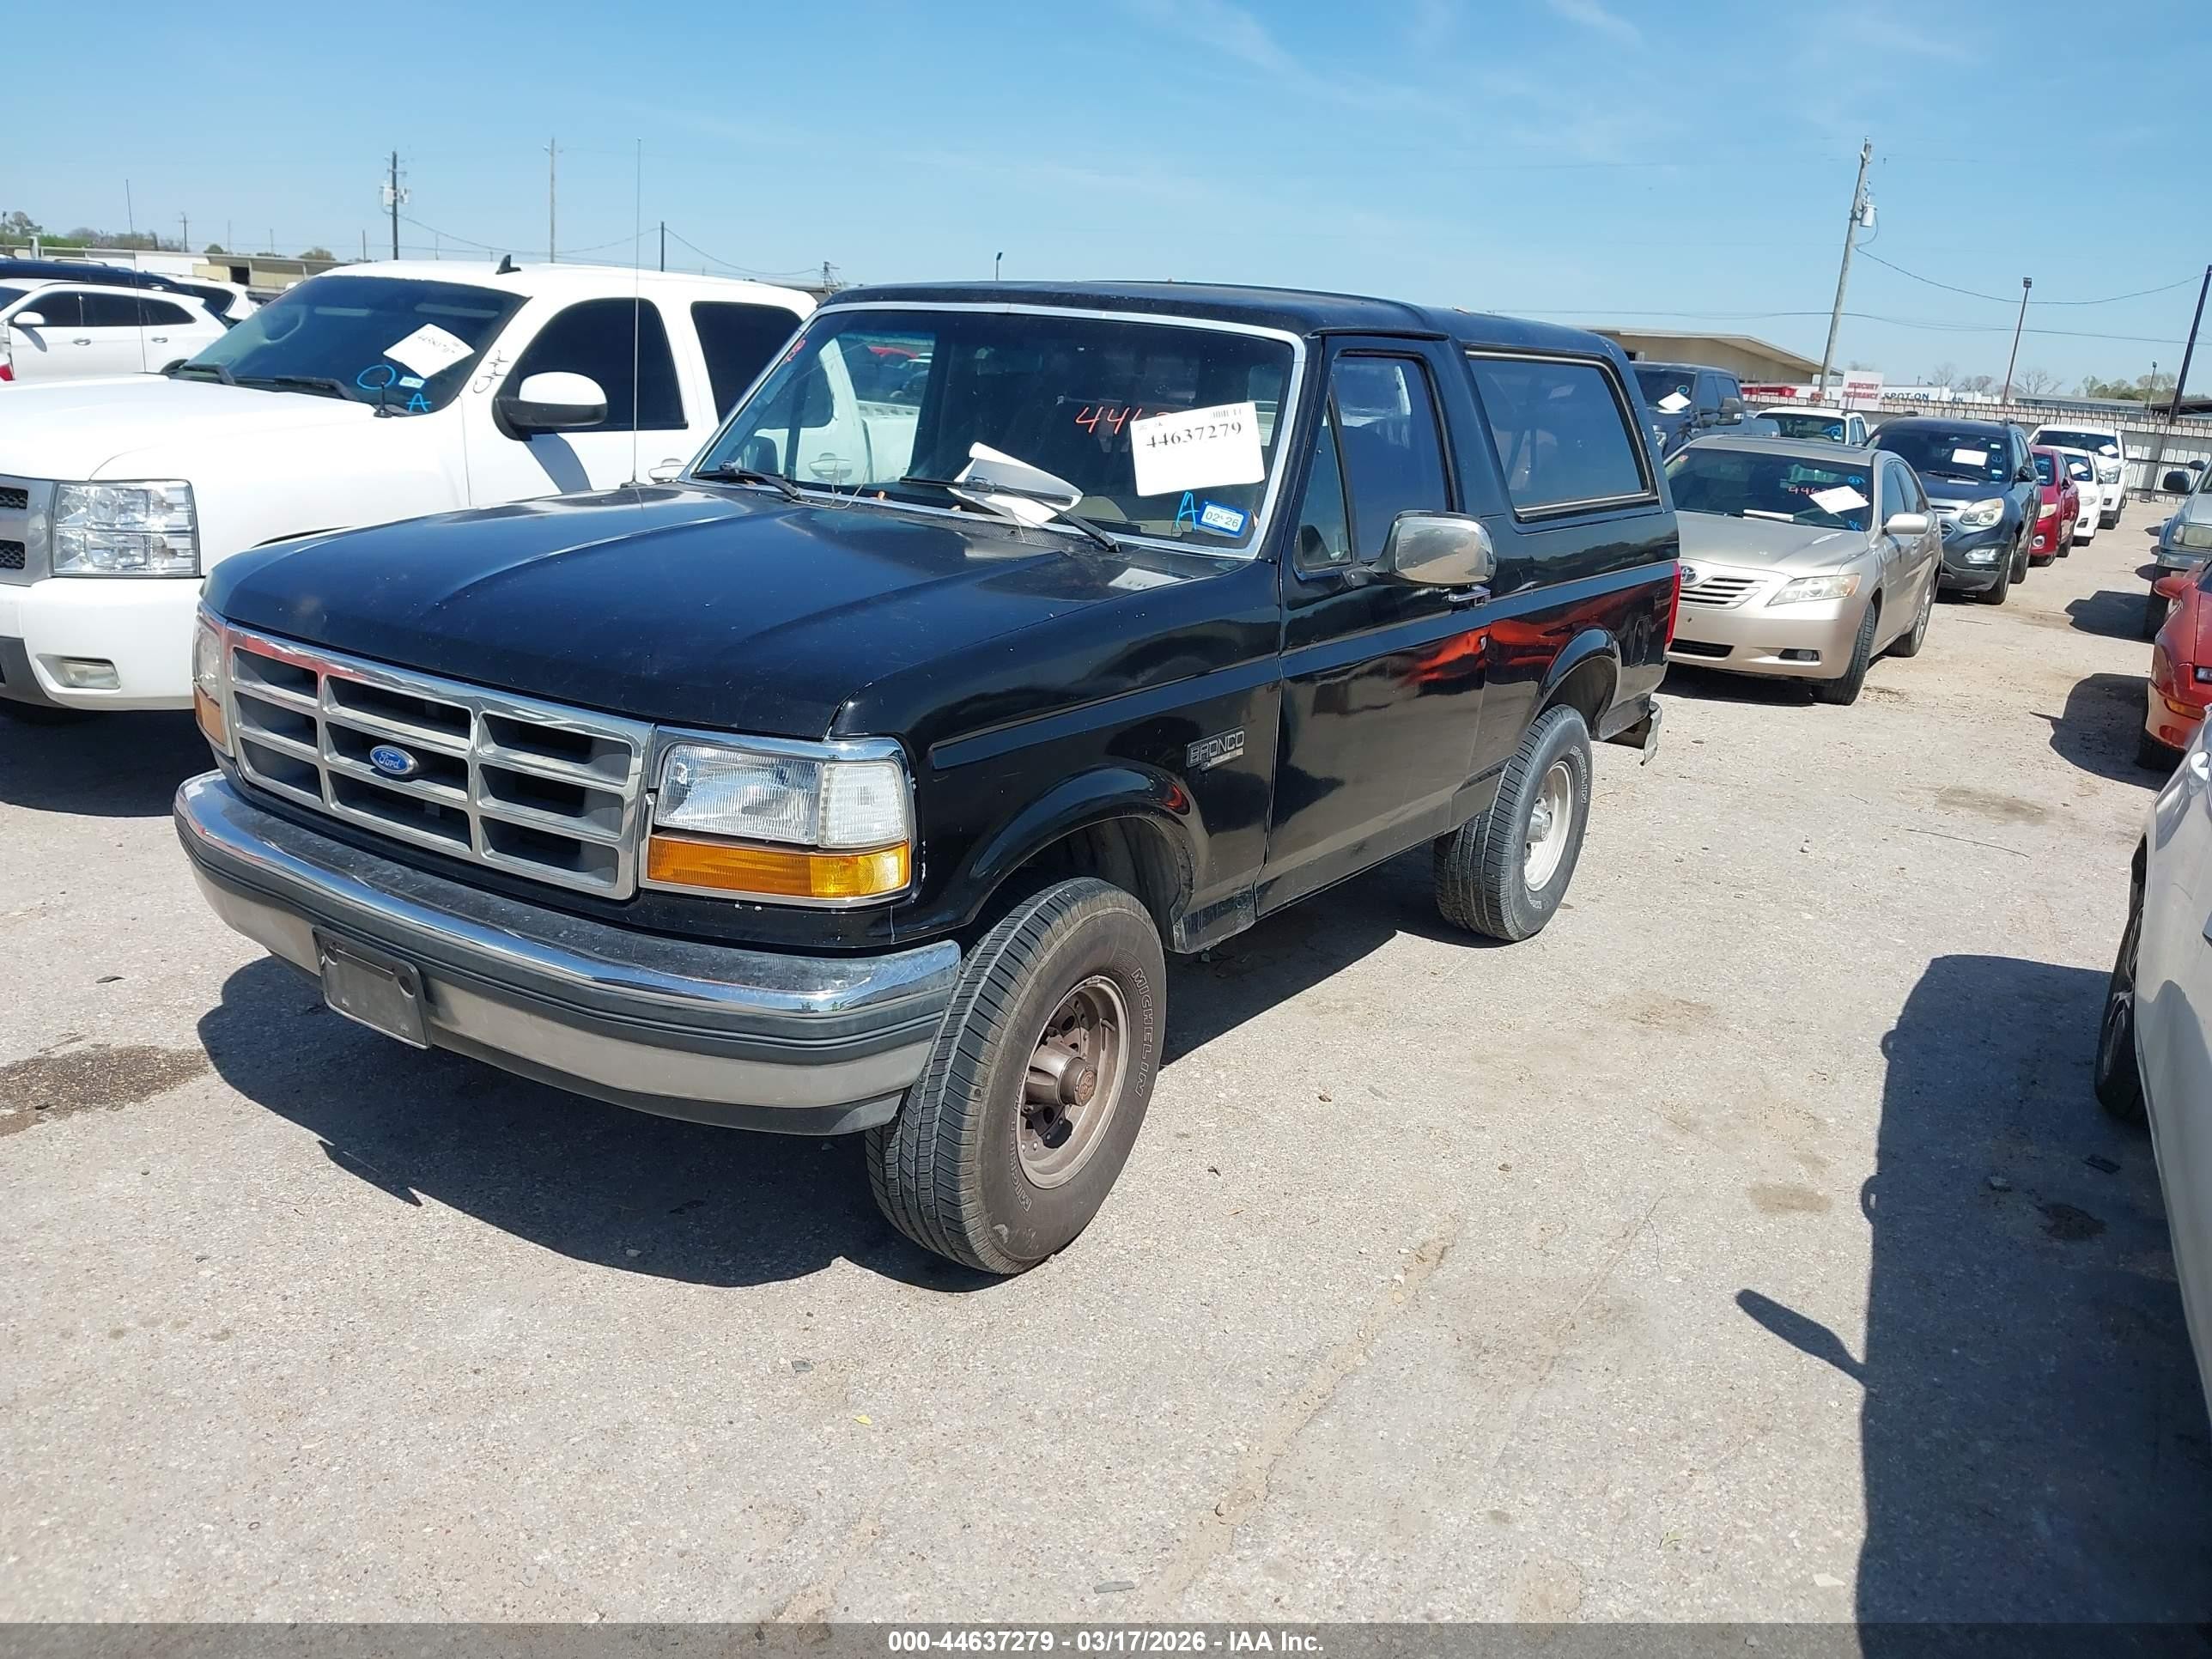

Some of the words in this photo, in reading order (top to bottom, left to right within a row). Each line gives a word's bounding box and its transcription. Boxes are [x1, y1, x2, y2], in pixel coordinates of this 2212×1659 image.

[406, 393, 432, 412] A
[1842, 391, 1879, 400] INSURANCE
[1146, 421, 1242, 448] 44637279
[1175, 491, 1200, 530] A
[378, 750, 401, 769] Ford
[1189, 730, 1245, 764] BRONCO
[1132, 968, 1155, 1097] MICHELIN
